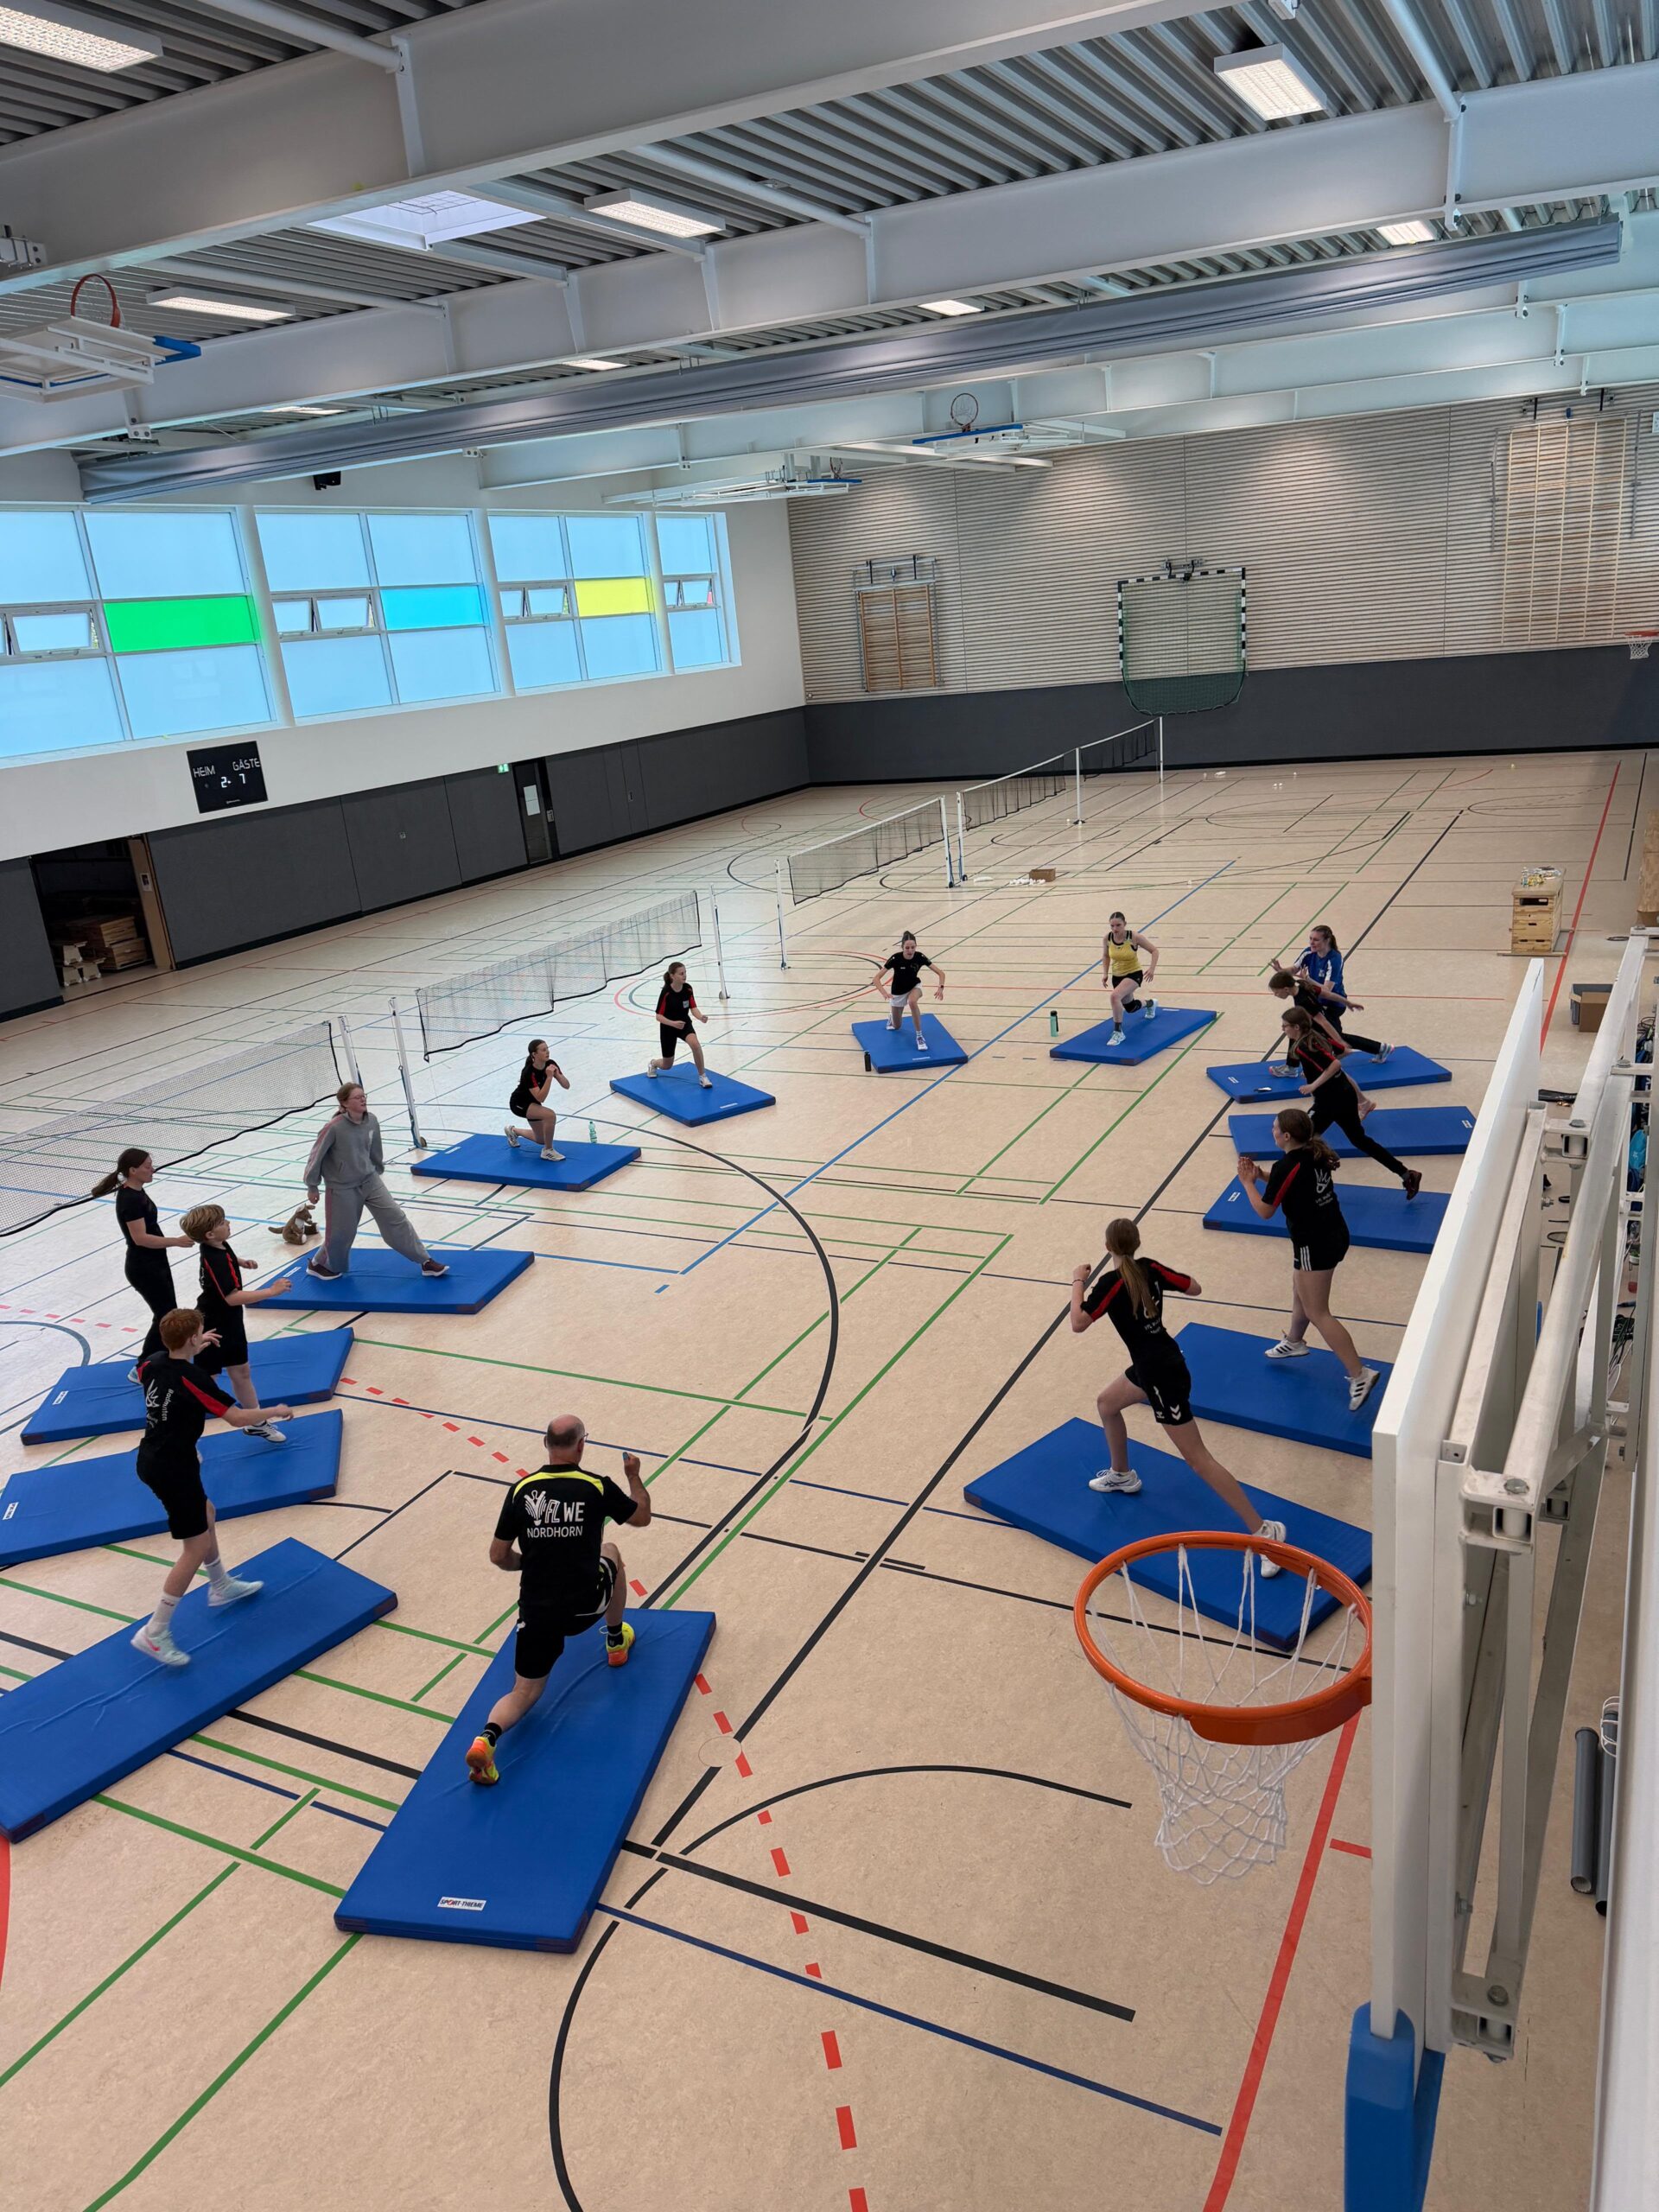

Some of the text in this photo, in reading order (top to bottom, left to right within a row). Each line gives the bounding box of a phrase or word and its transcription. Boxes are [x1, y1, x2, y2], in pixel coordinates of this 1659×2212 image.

[193, 758, 261, 778] HEIM GÄSTE
[161, 1389, 175, 1421] Badminton
[563, 1502, 586, 1522] WE
[527, 1526, 583, 1538] NORDHORN
[439, 1898, 485, 1909] SPORT-THIEME
